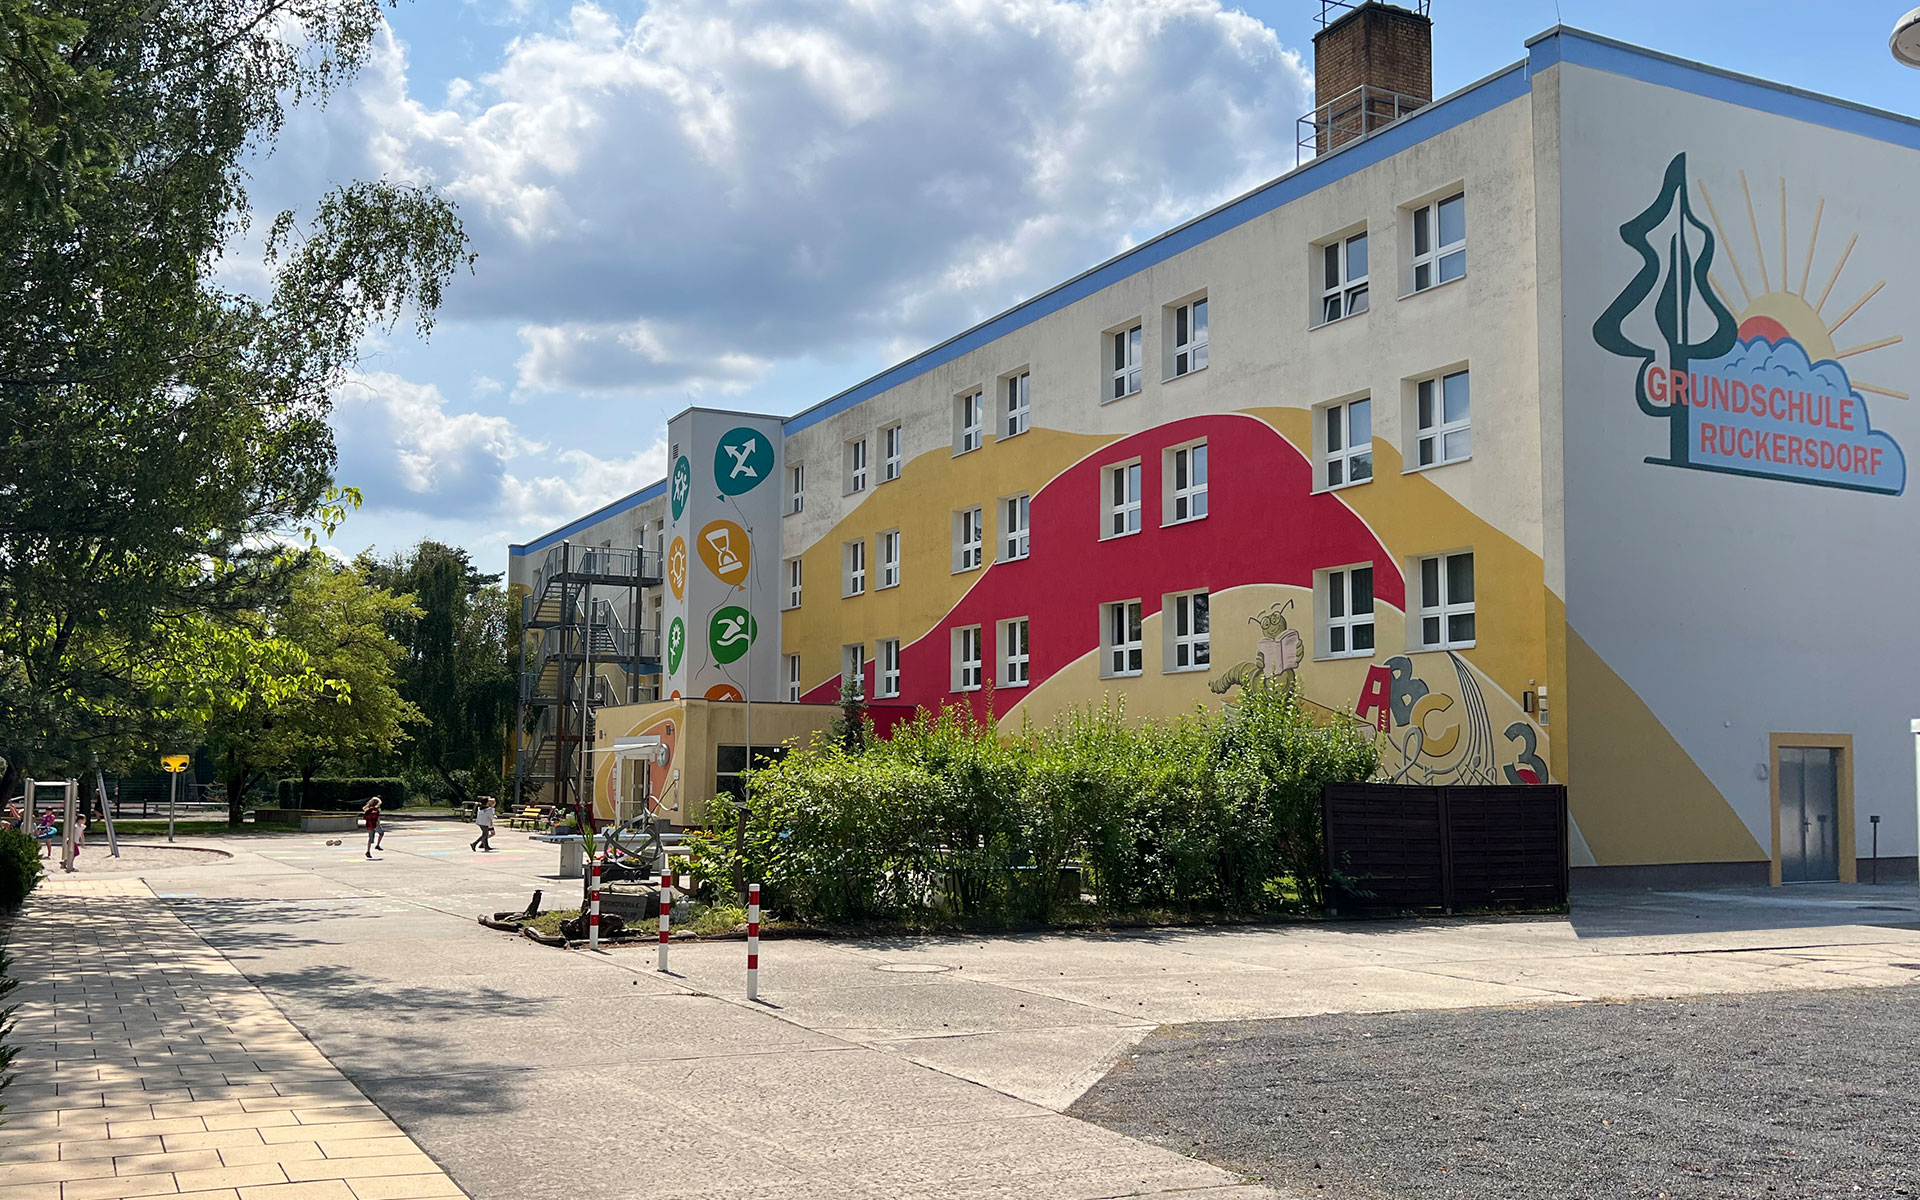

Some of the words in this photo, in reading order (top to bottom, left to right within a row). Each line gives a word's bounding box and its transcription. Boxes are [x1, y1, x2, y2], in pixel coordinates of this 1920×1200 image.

[1648, 367, 1854, 431] GRUNDSCHULE
[1701, 422, 1883, 475] RÜCKERSDORF
[1355, 655, 1460, 757] ABC
[1503, 722, 1549, 784] 3
